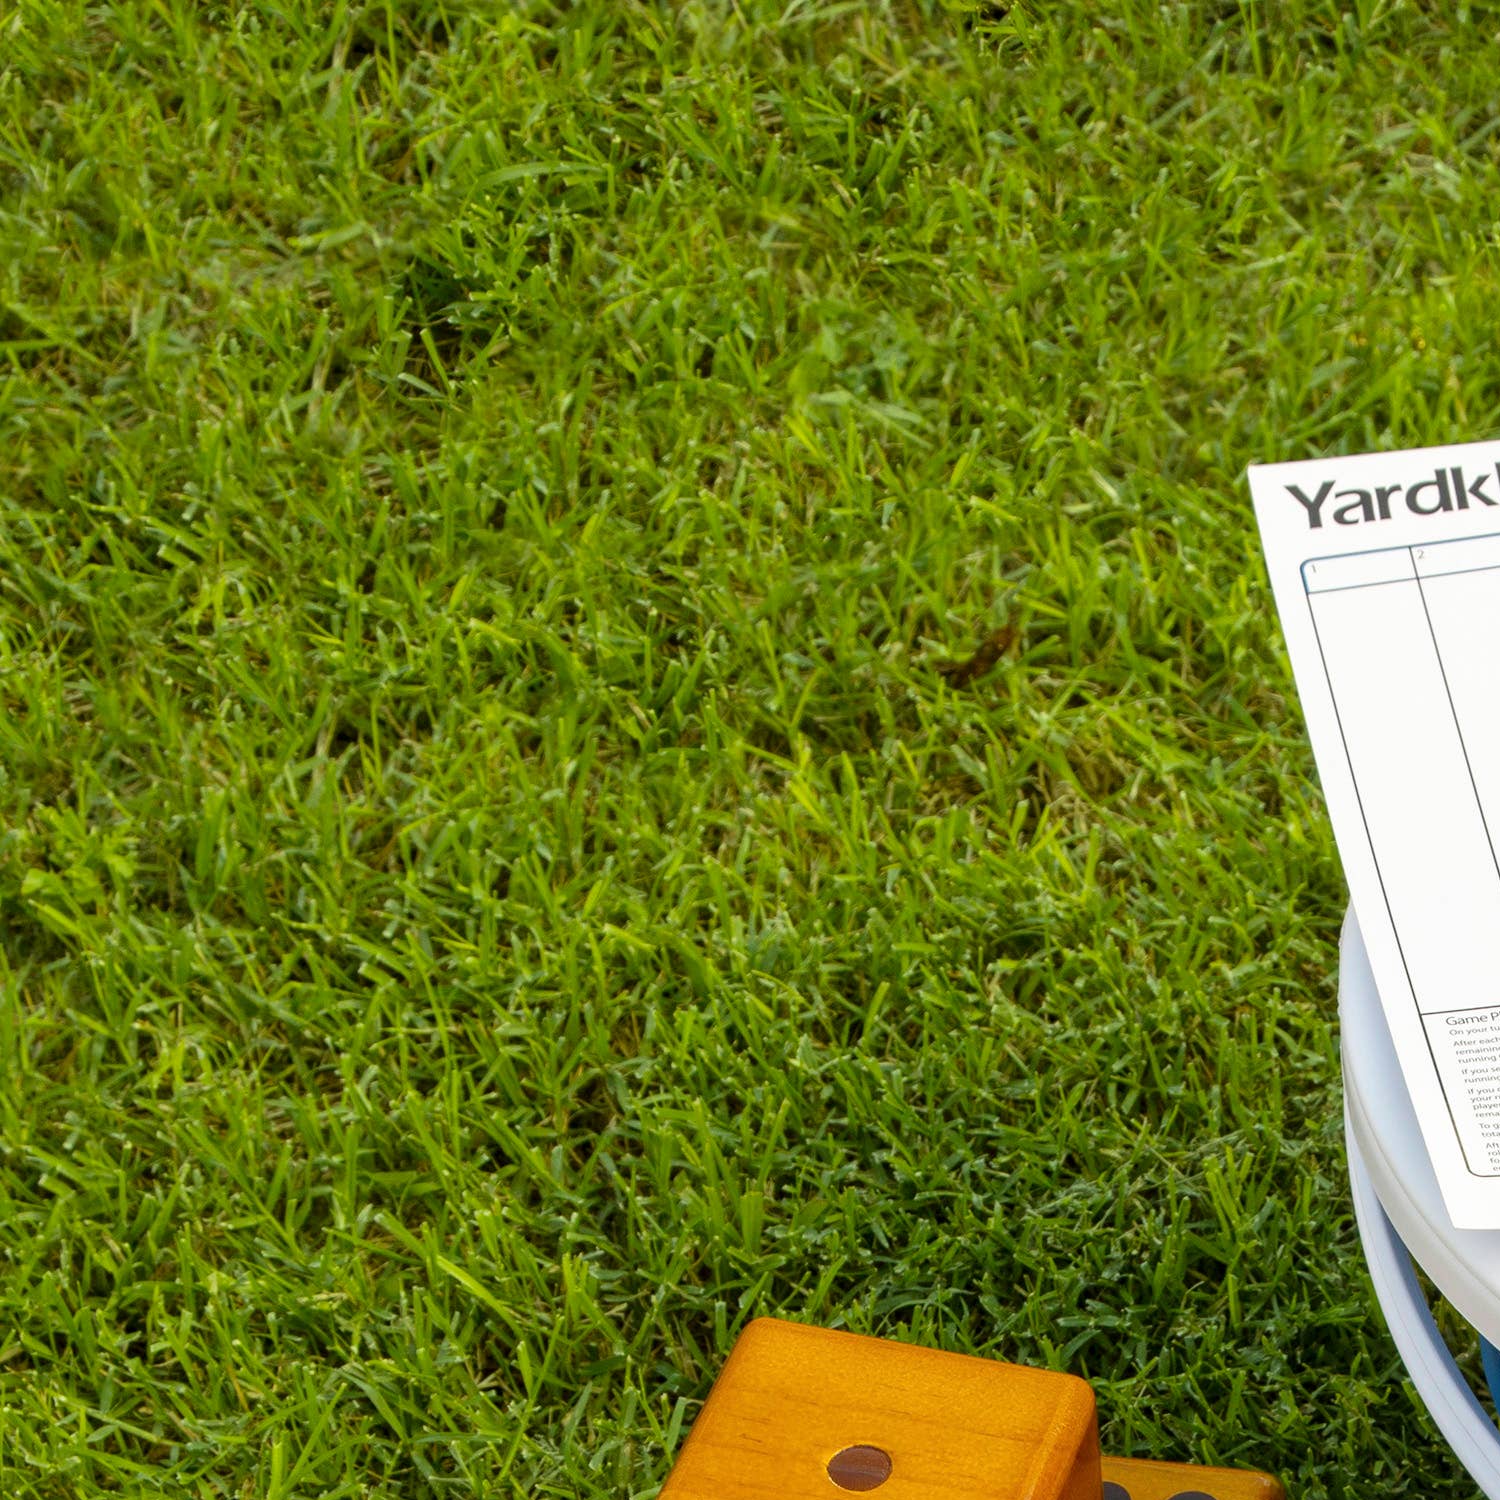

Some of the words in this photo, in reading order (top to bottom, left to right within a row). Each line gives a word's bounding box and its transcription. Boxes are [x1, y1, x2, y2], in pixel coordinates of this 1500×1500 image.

[1445, 1014, 1489, 1026] Game
[1448, 1028, 1465, 1036] On
[1465, 1027, 1488, 1035] your
